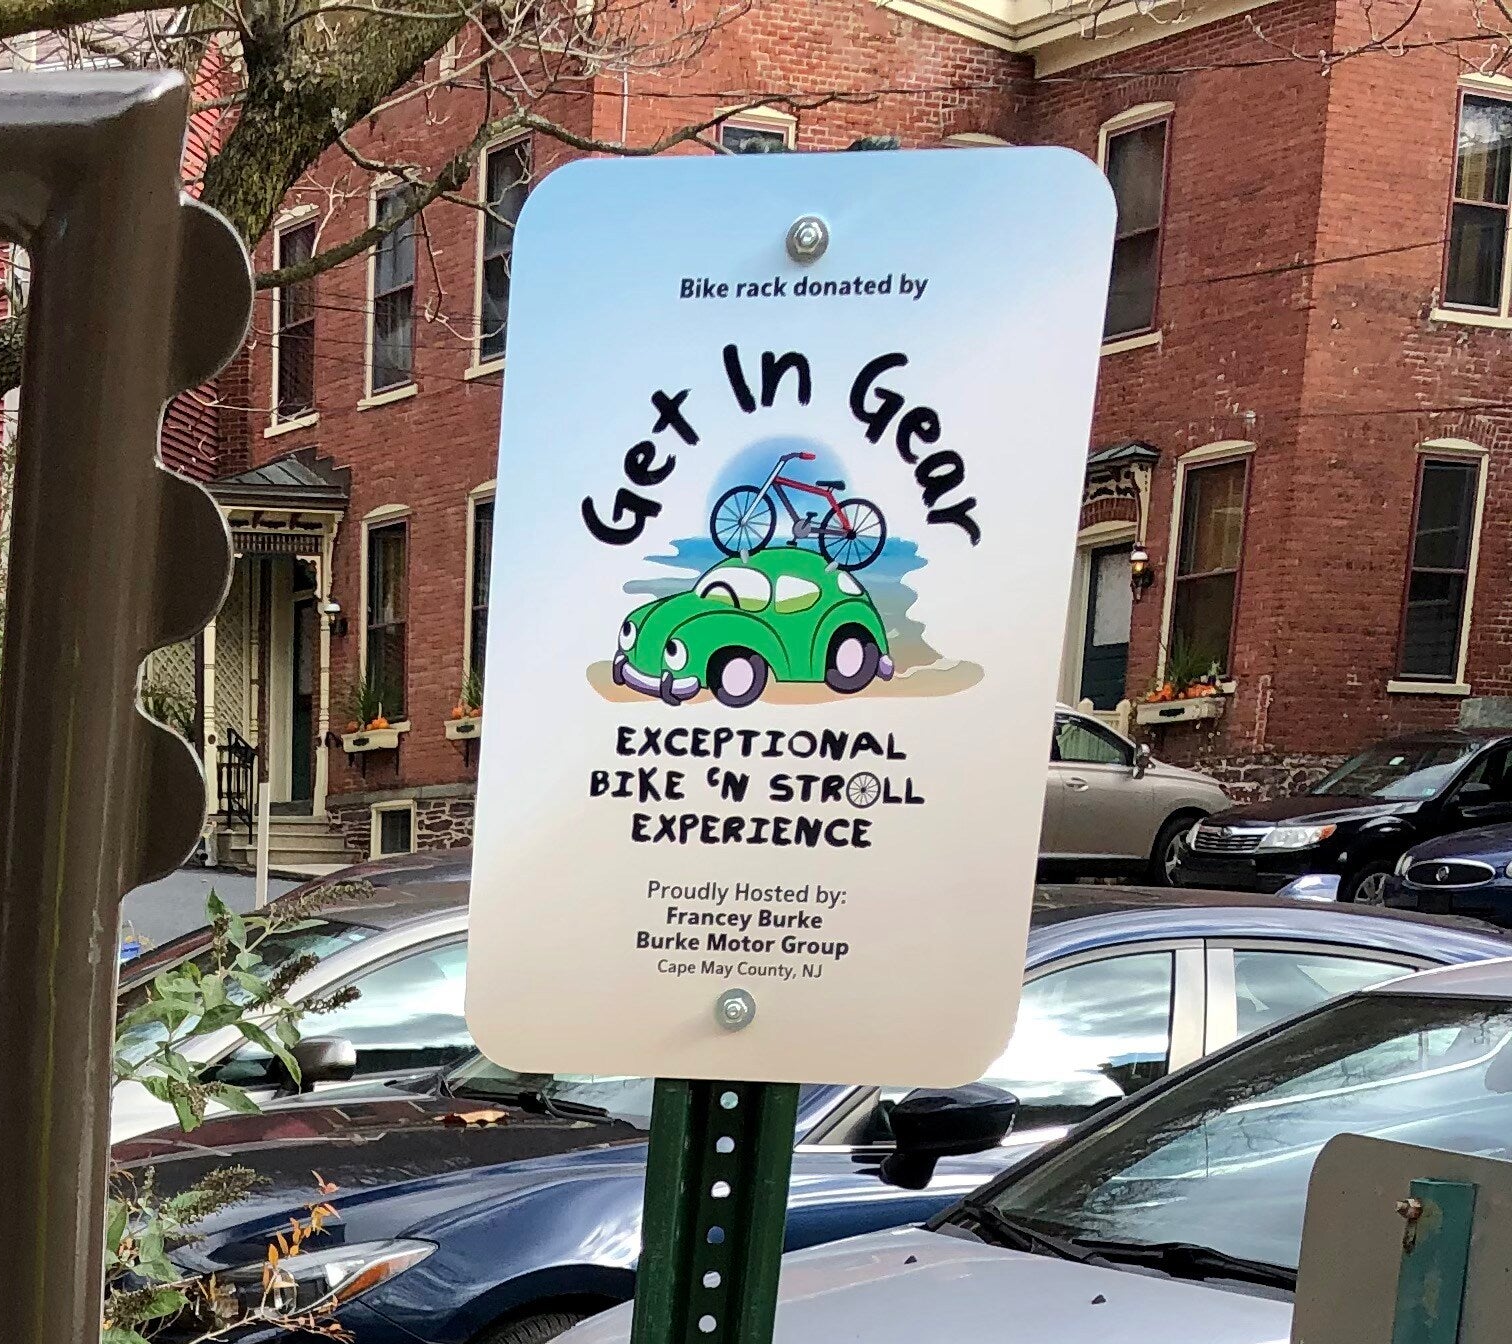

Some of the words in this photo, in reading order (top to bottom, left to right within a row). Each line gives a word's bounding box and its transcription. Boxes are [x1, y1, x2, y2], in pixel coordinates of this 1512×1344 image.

[679, 277, 729, 299] Bike
[736, 275, 788, 298] rack
[793, 274, 893, 297] donated
[898, 273, 929, 301] by
[580, 387, 701, 546] Get
[722, 343, 812, 415] In
[848, 351, 982, 548] Gear
[616, 726, 907, 761] EXCEPTIONAL
[589, 766, 685, 803] BIKE
[631, 812, 873, 849] EXPERIENCE
[647, 880, 730, 906] Proudly
[734, 882, 810, 903] Hosted
[815, 884, 847, 909] by:
[666, 906, 753, 932] Francey
[758, 909, 823, 929] Burke
[636, 930, 700, 951] Burke
[706, 933, 776, 953] Motor
[781, 935, 849, 961] Group
[657, 958, 696, 978] Cape
[700, 960, 734, 979] May
[737, 961, 797, 982] County,
[802, 963, 823, 979] NJ
